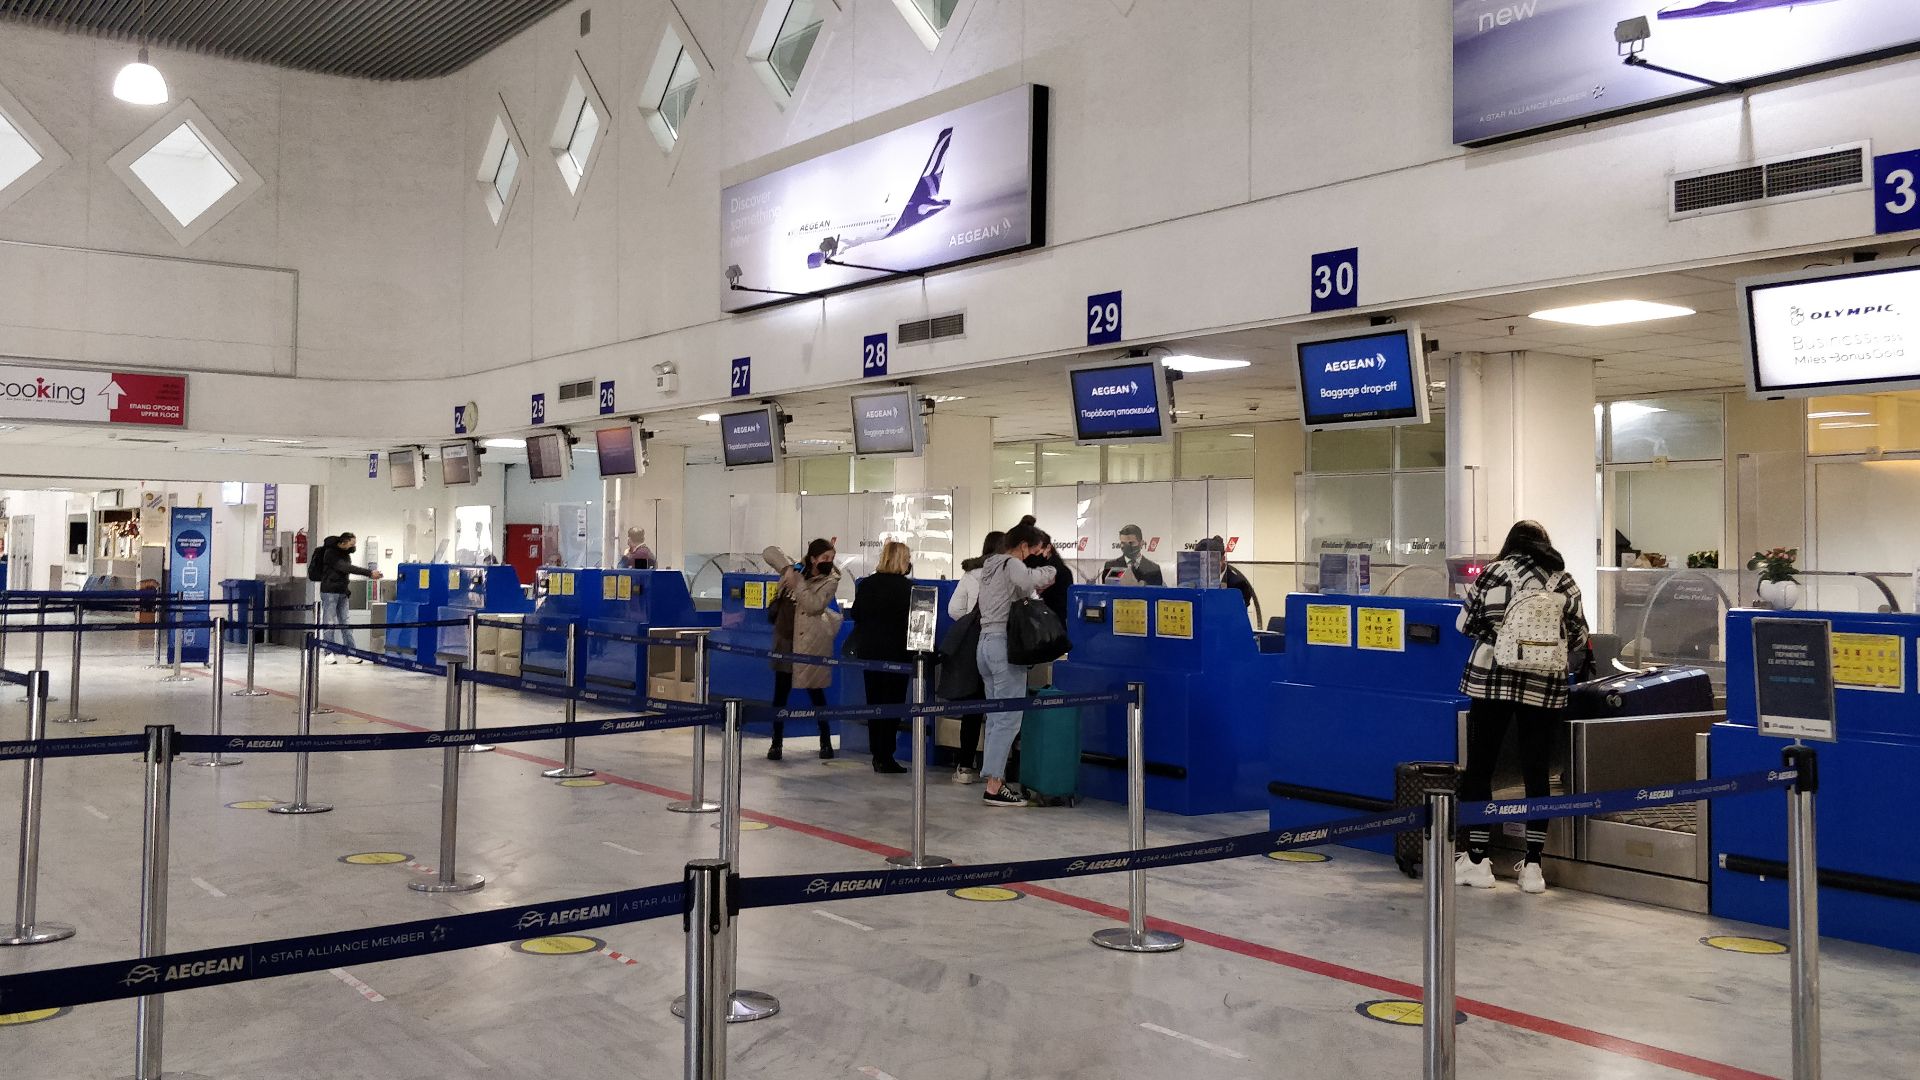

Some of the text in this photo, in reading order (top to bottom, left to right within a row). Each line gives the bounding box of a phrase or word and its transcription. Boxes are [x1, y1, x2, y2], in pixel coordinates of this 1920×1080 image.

[1478, 0, 1537, 32] new
[1487, 110, 1506, 122] STAR
[1508, 101, 1547, 117] ALLIANCE
[730, 191, 772, 214] Discover
[730, 205, 783, 231] something
[799, 219, 832, 232] AEGEAN
[948, 224, 1000, 247] AEGEAN
[1314, 261, 1355, 300] 30
[1089, 302, 1119, 335] 29
[1810, 304, 1895, 320] OLYMPIC
[864, 342, 886, 369] 28
[1324, 357, 1375, 373] AEGEAN
[732, 365, 749, 389] 27
[601, 388, 614, 408] 26
[1091, 384, 1130, 397] AEGEAN
[1320, 380, 1398, 400] Baggage drop-off
[152, 404, 179, 412] ΟΡΟΦΟΣ
[532, 400, 544, 419] 25
[865, 410, 892, 419] AEGEAN
[733, 425, 756, 435] AEGEAN
[1053, 539, 1079, 551] issport
[616, 720, 645, 730] AEGEAN
[246, 740, 284, 748] AEGEAN
[443, 733, 476, 743] AEGEAN
[1648, 789, 1674, 799] AEGEAN
[1498, 804, 1528, 815] AEGEAN
[1293, 828, 1329, 843] AEGEAN
[1086, 857, 1131, 871] AEGEAN
[830, 878, 884, 893] AEGEAN
[898, 877, 920, 885] STAR
[922, 874, 962, 884] ALLIANCE
[963, 870, 1000, 880] MEMBER
[548, 903, 611, 926] AEGEAN
[632, 897, 658, 910] STAR
[164, 955, 244, 982] AEGEAN
[271, 949, 304, 963] STAR
[307, 939, 369, 957] ALLIANCE
[371, 930, 425, 949] MEMBER
